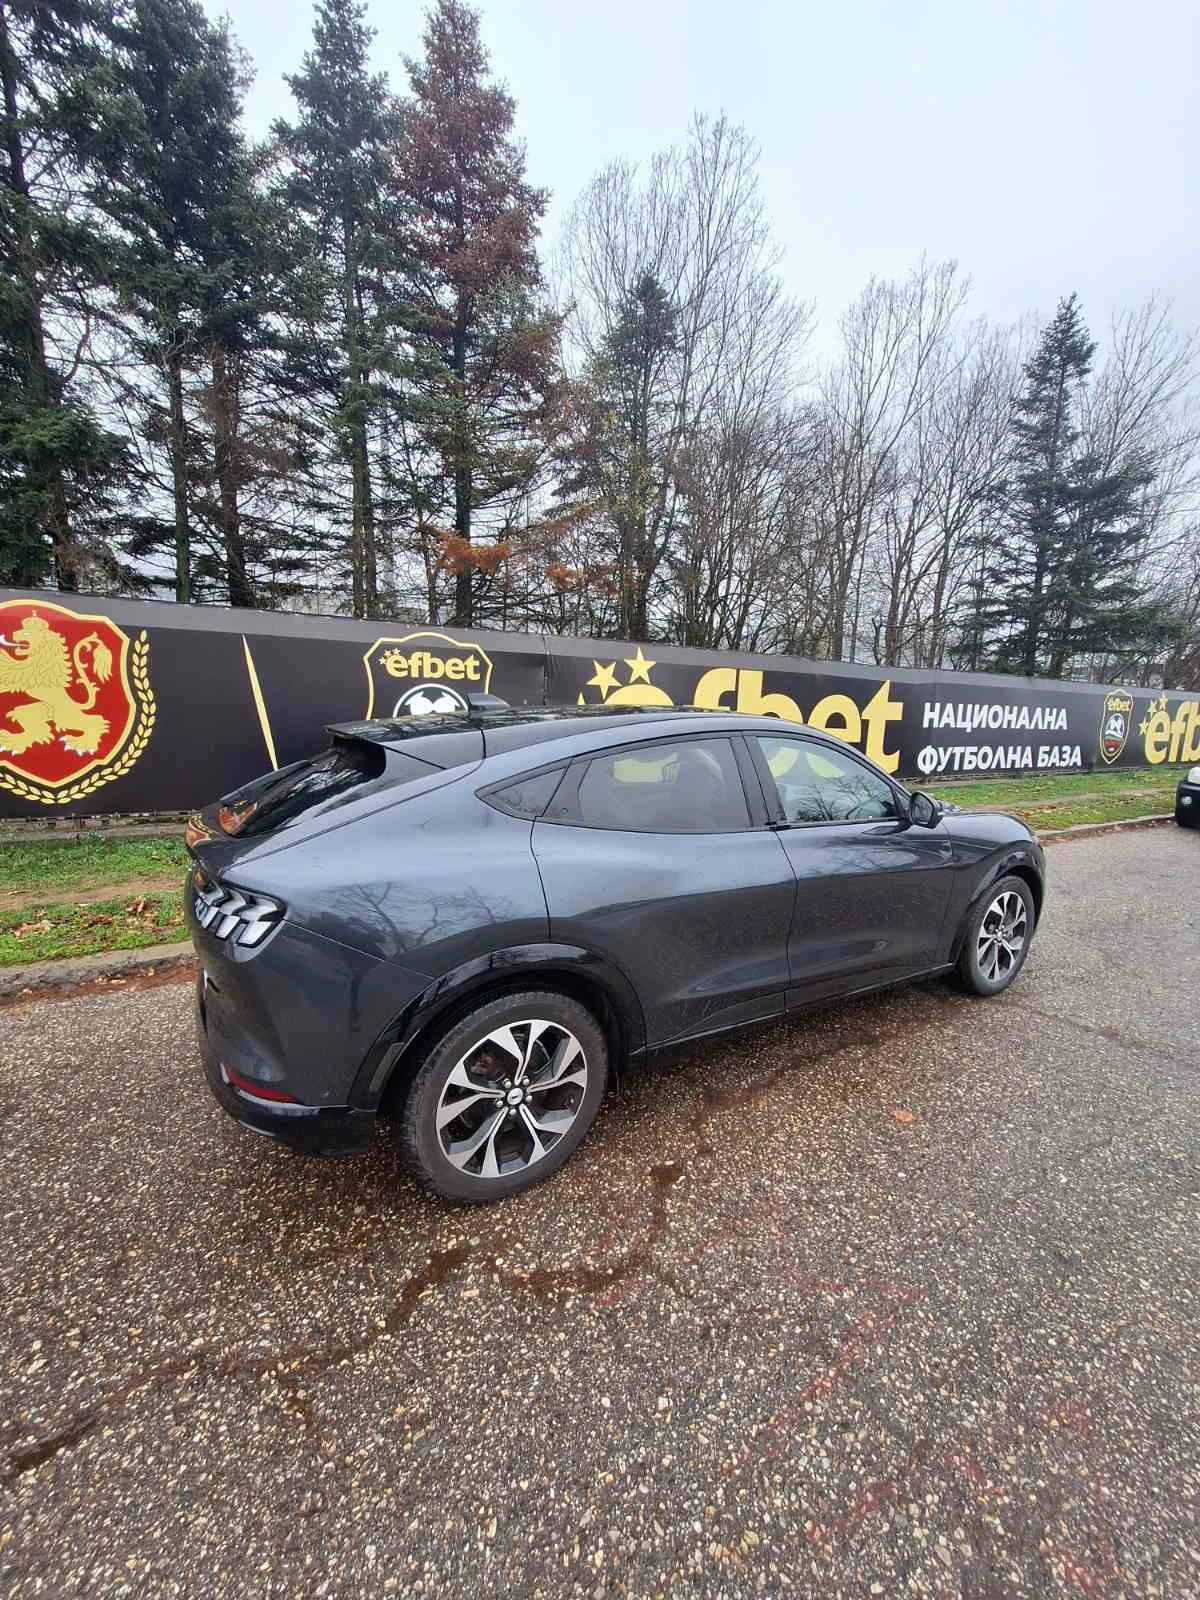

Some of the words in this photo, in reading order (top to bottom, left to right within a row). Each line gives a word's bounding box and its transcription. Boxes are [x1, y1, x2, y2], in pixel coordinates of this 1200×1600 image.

[386, 651, 481, 681] efbet
[604, 667, 904, 775] bet
[922, 701, 1068, 733] НАЦИОНАЛНА
[917, 745, 1033, 774] ФУТБОЛНА
[1036, 745, 1082, 768] БАЗА
